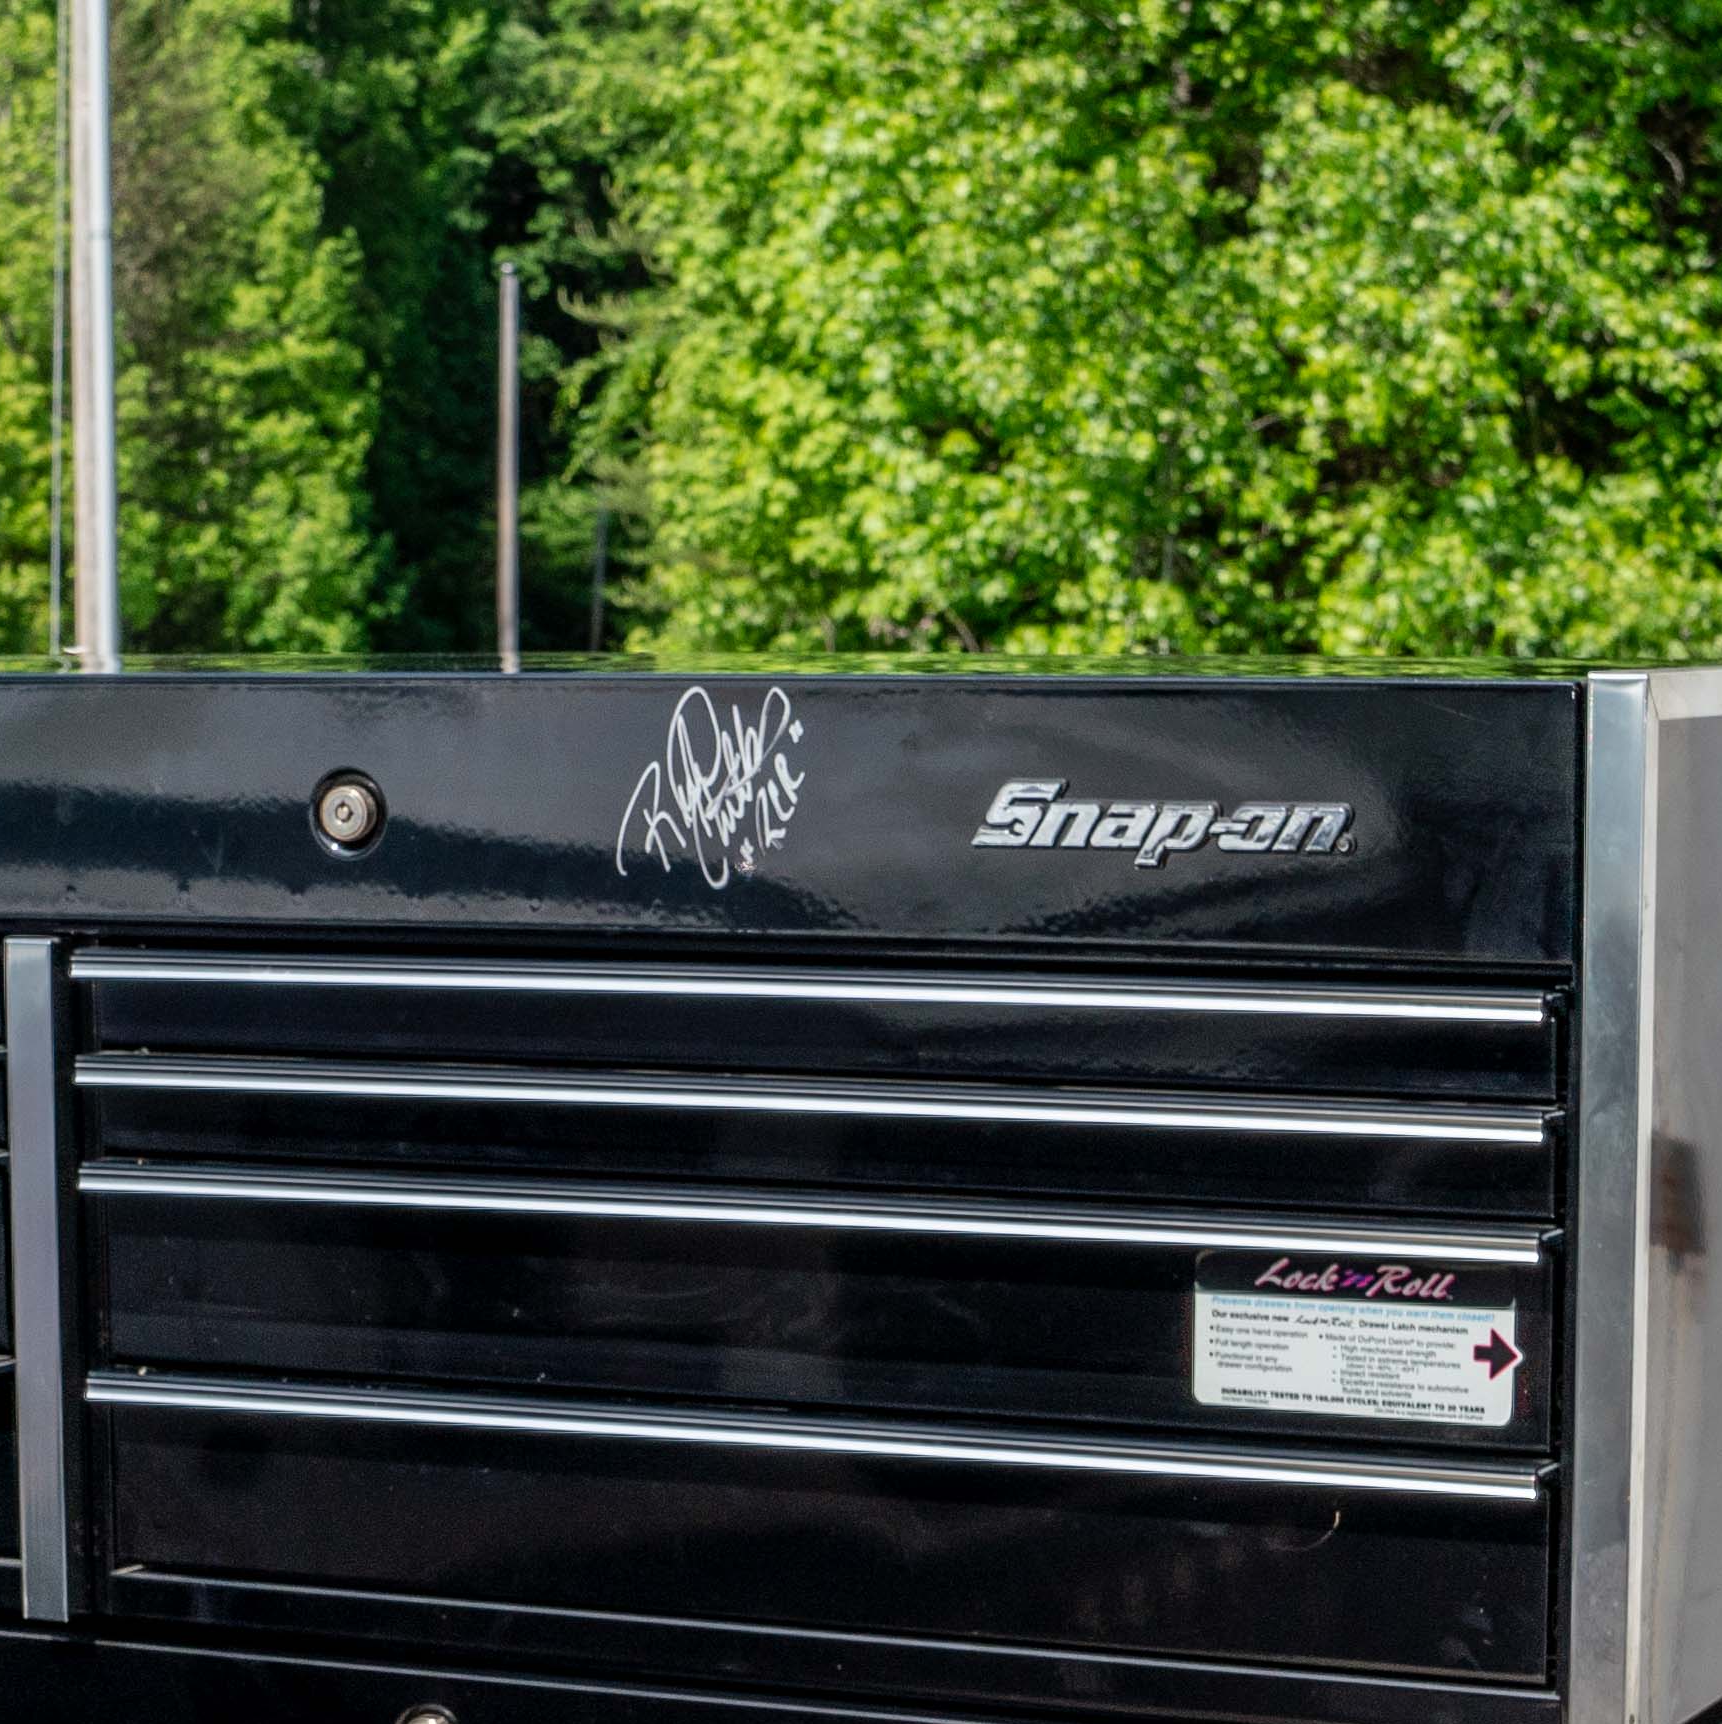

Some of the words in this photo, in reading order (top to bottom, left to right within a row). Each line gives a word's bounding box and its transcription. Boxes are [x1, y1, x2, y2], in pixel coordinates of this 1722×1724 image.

[971, 777, 1357, 867] Snap-on
[1254, 1257, 1340, 1293] Lock
[1365, 1265, 1456, 1300] Roll
[1293, 1302, 1316, 1310] from
[1318, 1303, 1355, 1314] opening
[1357, 1304, 1383, 1314] when
[1386, 1307, 1403, 1317] you
[1212, 1309, 1227, 1319] Our
[1229, 1311, 1270, 1322] exclusive
[1272, 1314, 1289, 1323] new
[1359, 1319, 1389, 1329] Drawer
[1391, 1320, 1416, 1331] Latch
[1418, 1324, 1469, 1335] mechanism
[1216, 1325, 1234, 1335] Easy
[1252, 1328, 1271, 1336] hand
[1273, 1330, 1308, 1339] operation
[1325, 1334, 1346, 1342] Made
[1215, 1339, 1228, 1347] Full
[1230, 1340, 1252, 1349] length
[1254, 1342, 1289, 1350] operation
[1340, 1344, 1358, 1353] High
[1360, 1346, 1404, 1356] mechanical
[1406, 1349, 1437, 1359] strength
[1215, 1351, 1254, 1360] Functional
[1244, 1363, 1293, 1372] configuration
[1410, 1358, 1461, 1369] temperatures
[1340, 1369, 1365, 1378] Impact
[1368, 1371, 1400, 1380] resistant
[1340, 1377, 1374, 1387] Excellent
[1376, 1380, 1415, 1390] resistance
[1426, 1384, 1470, 1395] automotive
[1364, 1388, 1379, 1396] and
[1221, 1387, 1268, 1397] DURABILITY
[1270, 1391, 1300, 1400] TESTED
[1302, 1393, 1313, 1402] TO
[1381, 1399, 1431, 1409] EQUIVALENT
[1435, 1403, 1445, 1411] TO
[1459, 1404, 1485, 1414] YEARS
